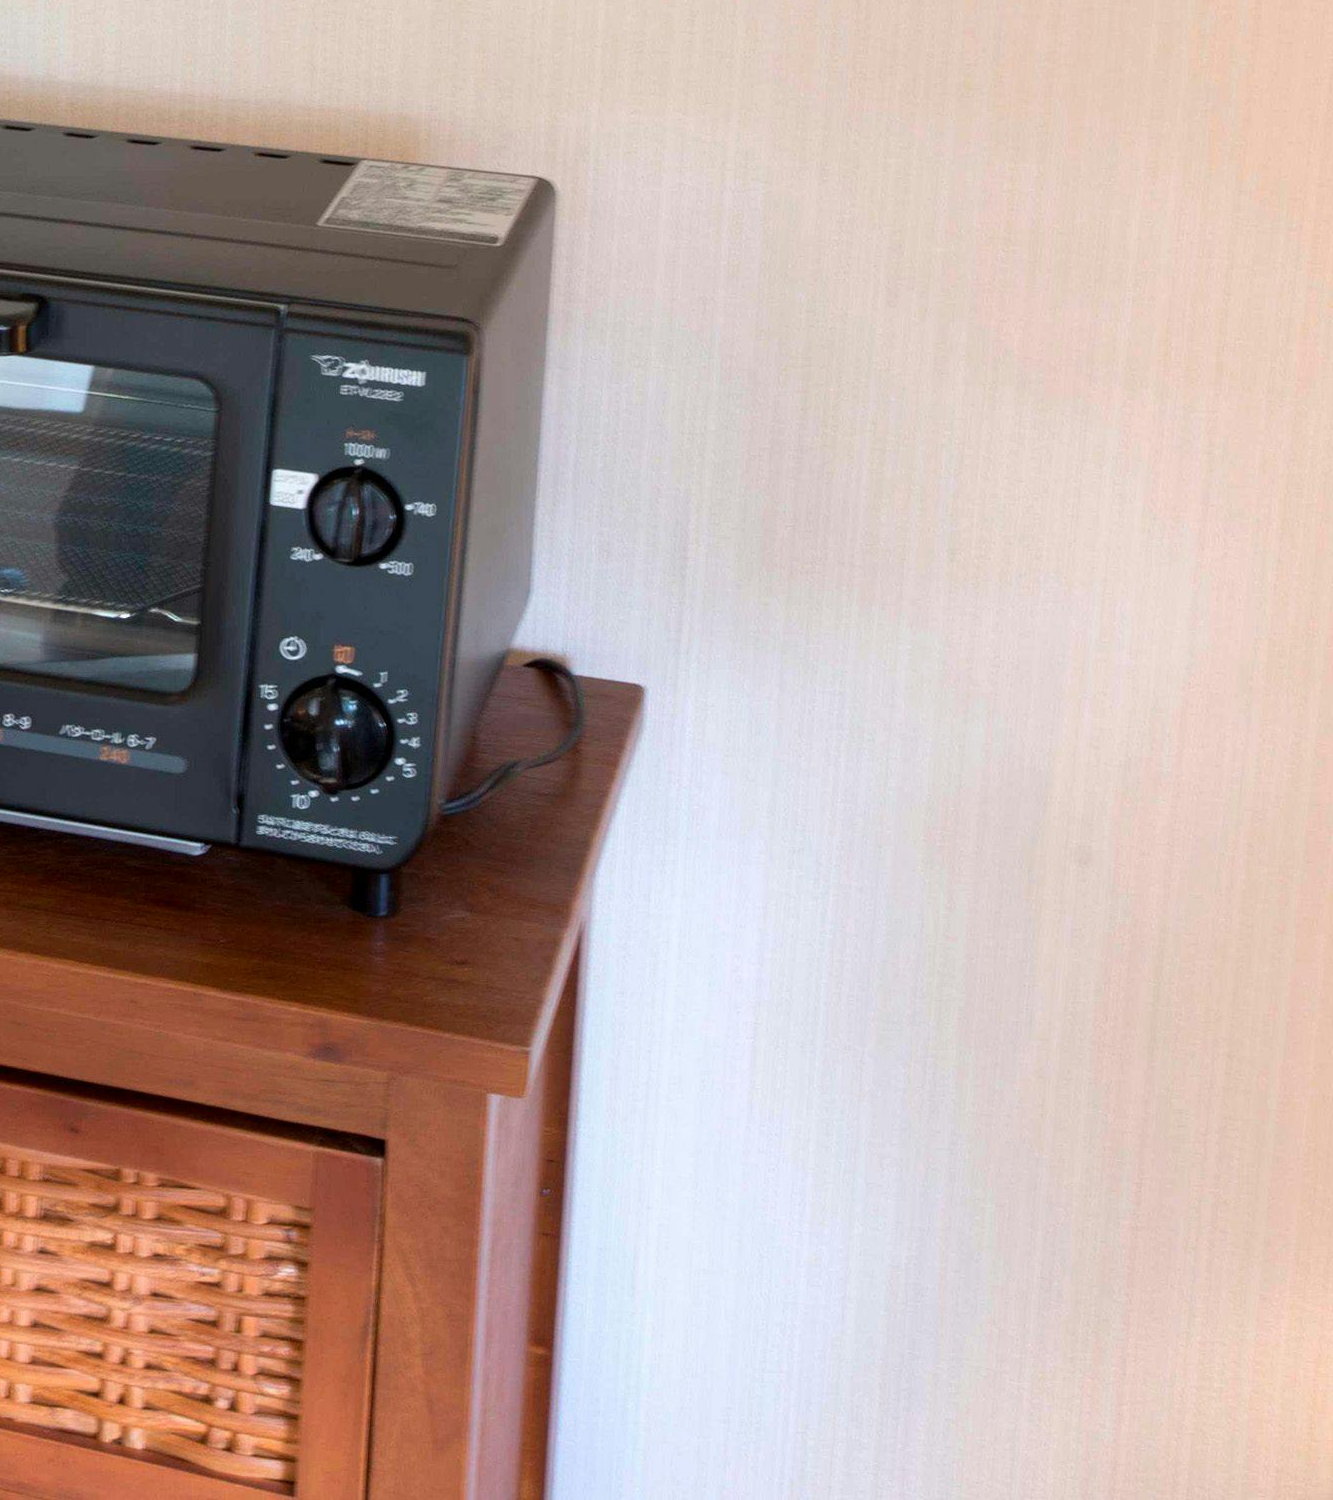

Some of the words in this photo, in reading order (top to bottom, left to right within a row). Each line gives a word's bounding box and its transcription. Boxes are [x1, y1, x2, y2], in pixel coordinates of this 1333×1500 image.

[342, 360, 426, 387] ZOJIRUSHI
[259, 684, 279, 700] 15
[396, 689, 409, 702] 2
[406, 712, 419, 725] 3
[127, 734, 157, 750] 6-7
[409, 736, 422, 749] 4
[403, 763, 417, 779] 5
[290, 794, 311, 810] 10
